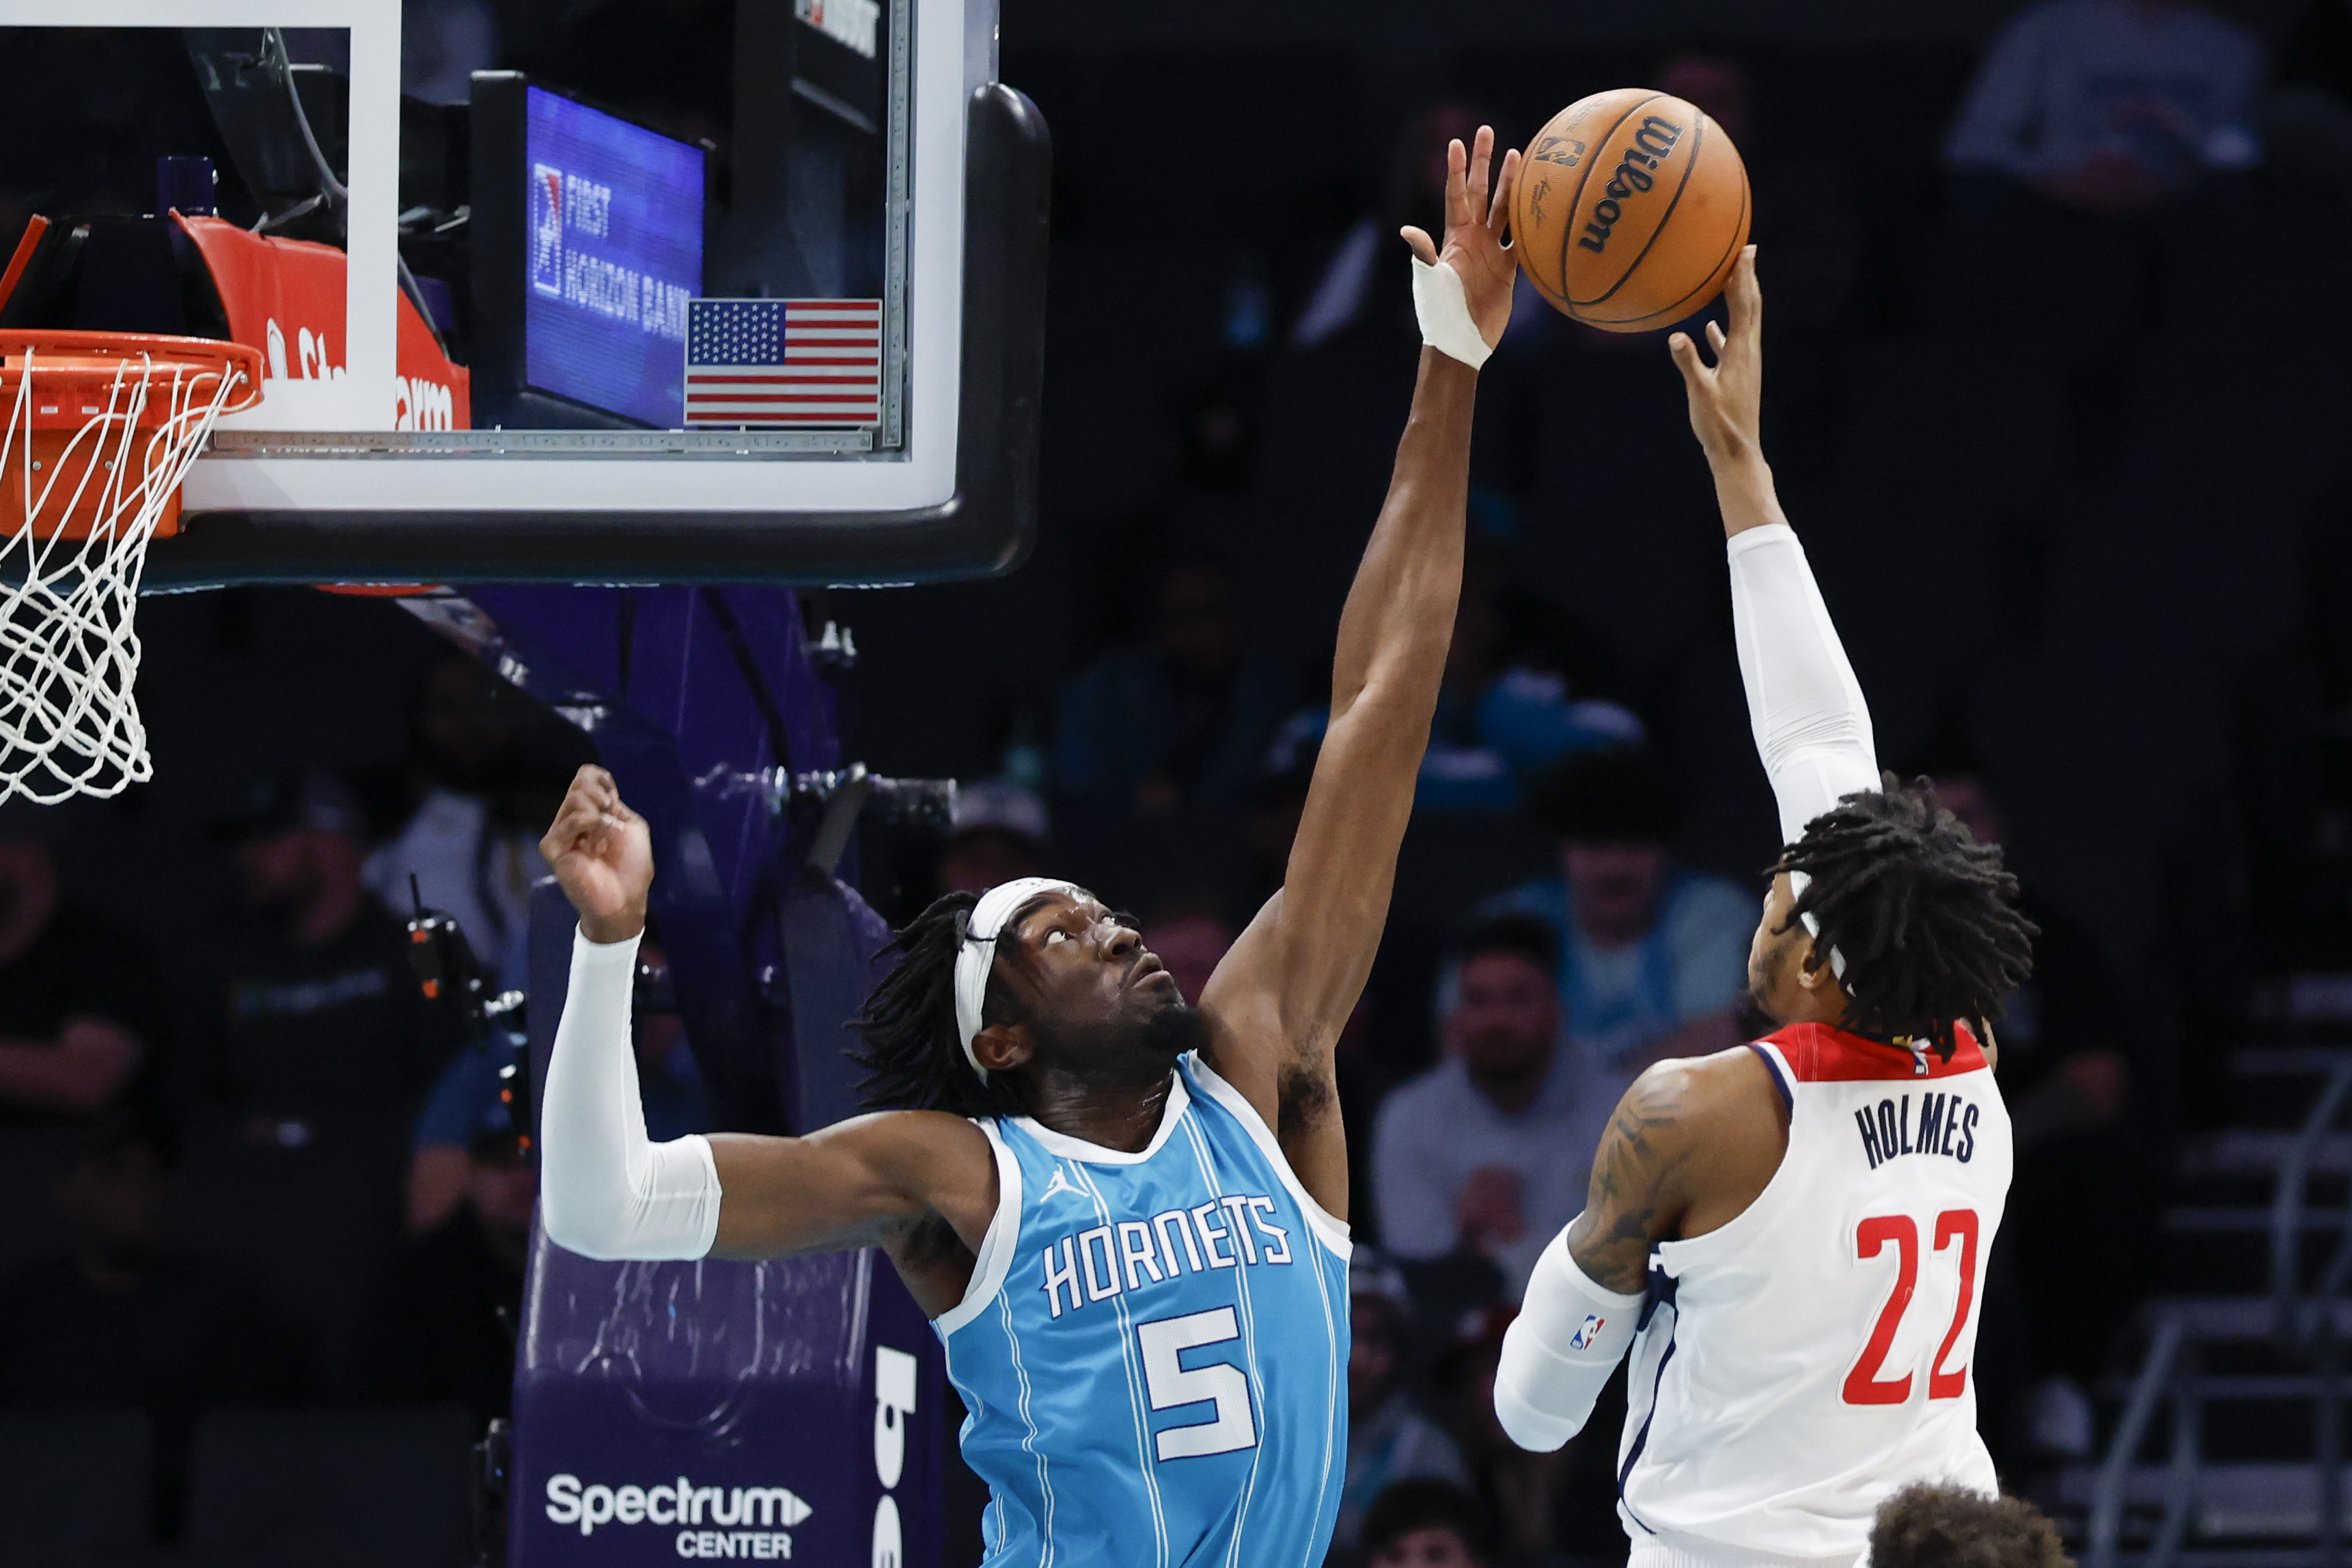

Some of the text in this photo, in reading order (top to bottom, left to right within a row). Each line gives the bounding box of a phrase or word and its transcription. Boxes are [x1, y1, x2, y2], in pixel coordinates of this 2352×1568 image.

[1578, 115, 1685, 255] Wilson
[1854, 1092, 1979, 1171] HOLMES
[1039, 1194, 1293, 1319] HORNETS
[1841, 1208, 1979, 1405] 22
[1137, 1304, 1258, 1463] 5
[546, 1473, 798, 1536] Spectrum
[676, 1530, 792, 1559] CENTER
